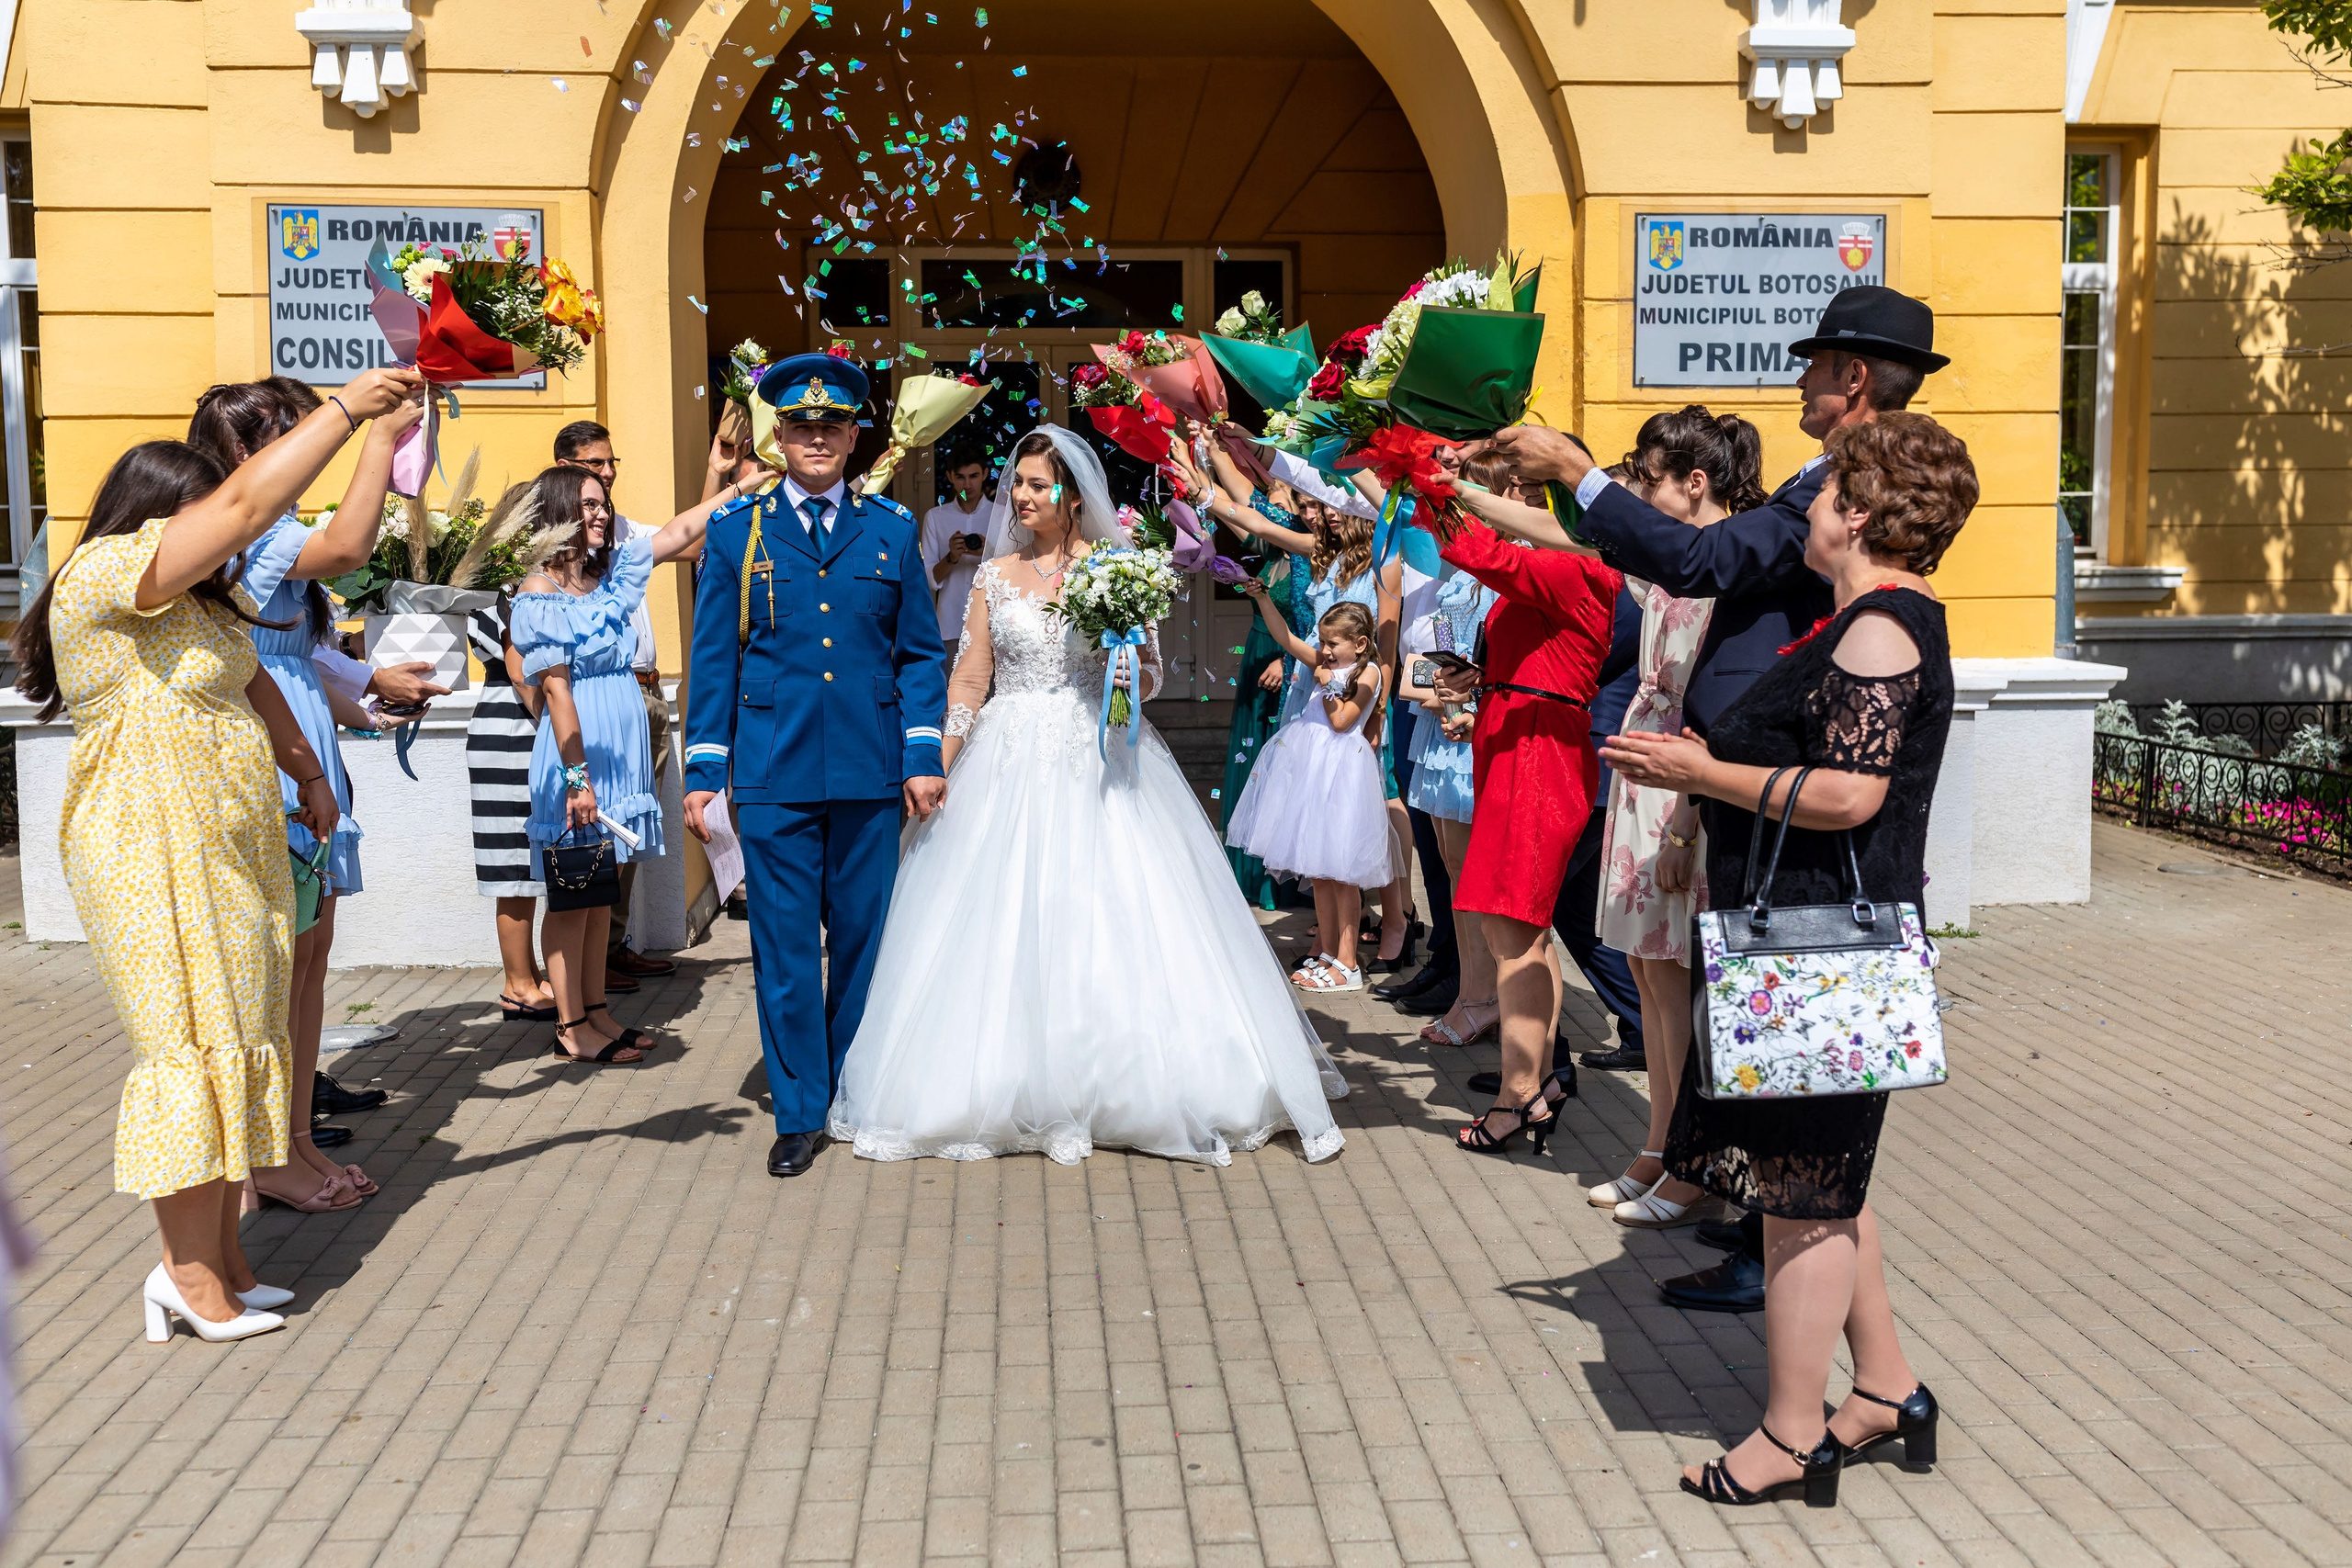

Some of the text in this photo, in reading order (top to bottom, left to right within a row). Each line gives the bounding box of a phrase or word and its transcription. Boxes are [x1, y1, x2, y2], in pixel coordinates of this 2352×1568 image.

[327, 217, 487, 243] ROMÂNIA
[1690, 223, 1835, 248] ROMÂNIA
[1641, 275, 1750, 294] JUDETUL
[1640, 308, 1767, 324] MUNICIPIUL
